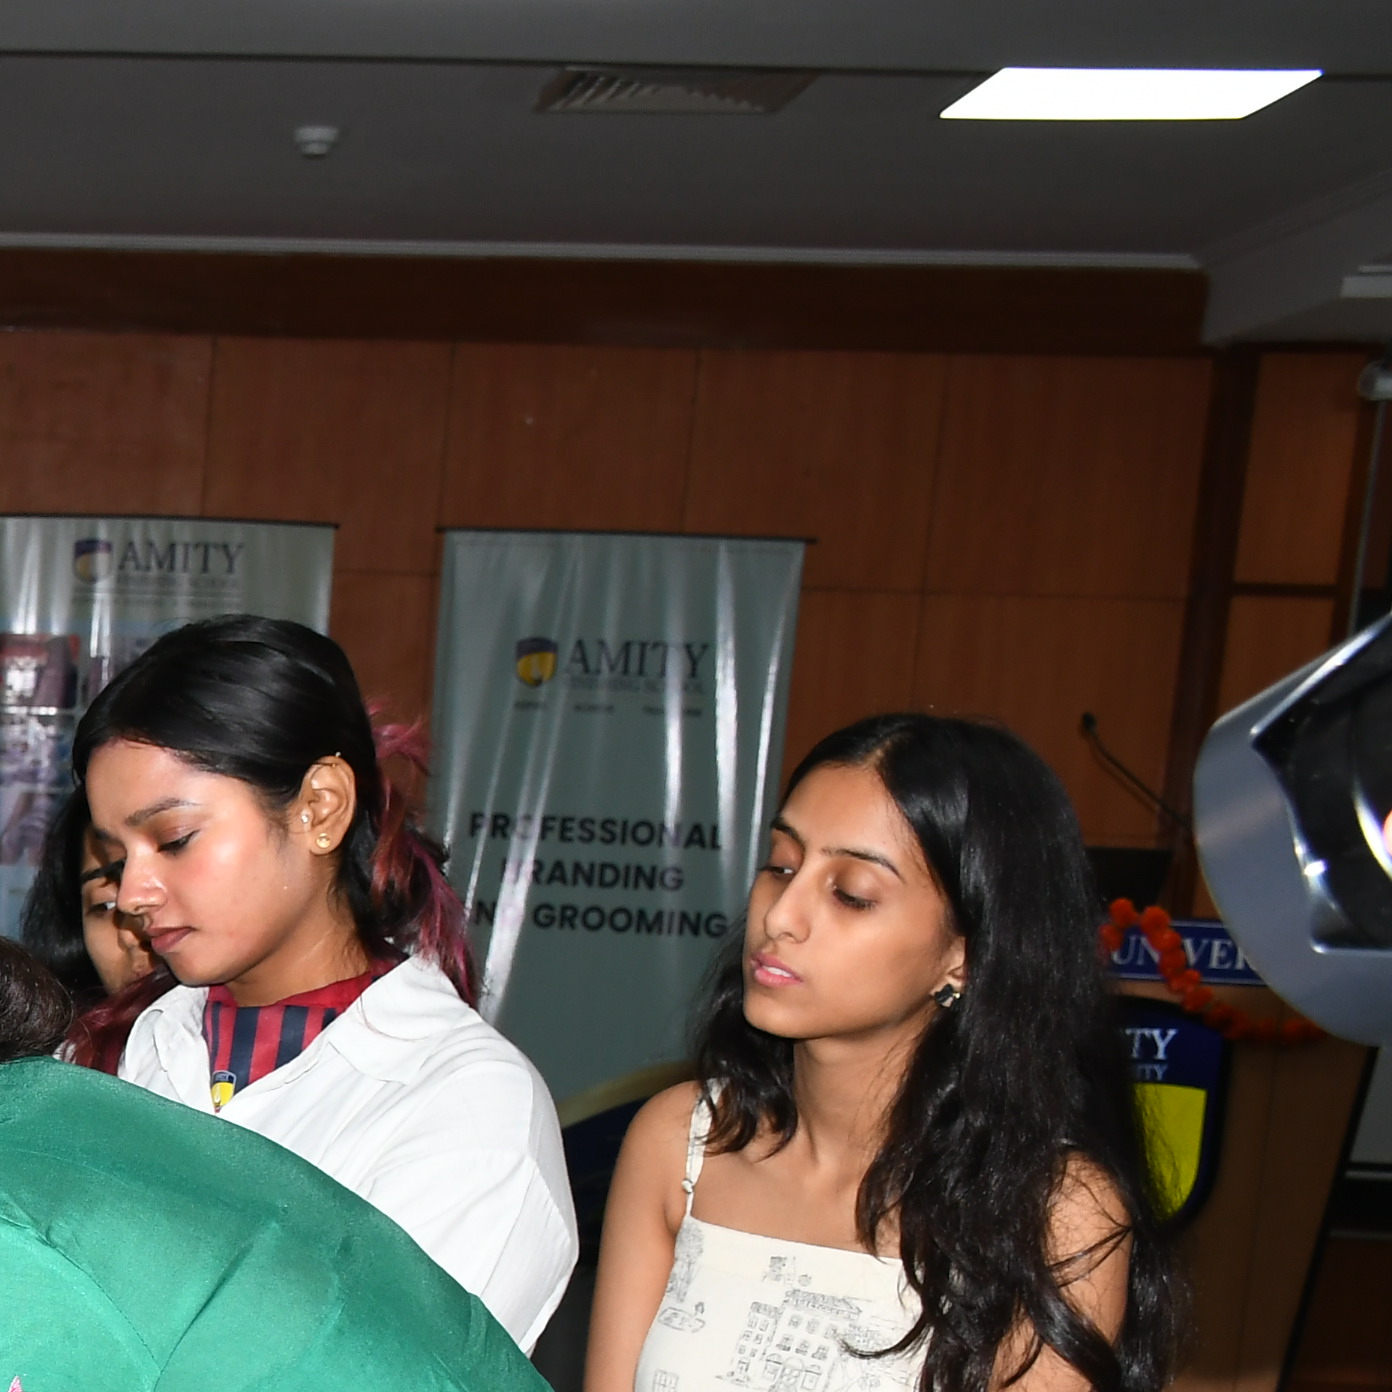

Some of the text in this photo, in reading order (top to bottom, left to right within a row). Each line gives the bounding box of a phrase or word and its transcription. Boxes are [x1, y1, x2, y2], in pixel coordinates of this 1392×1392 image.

[118, 541, 243, 574] AMITY
[569, 638, 710, 678] AMITY
[468, 811, 723, 850] PROFESSIONAL
[532, 902, 728, 938] GROOMING
